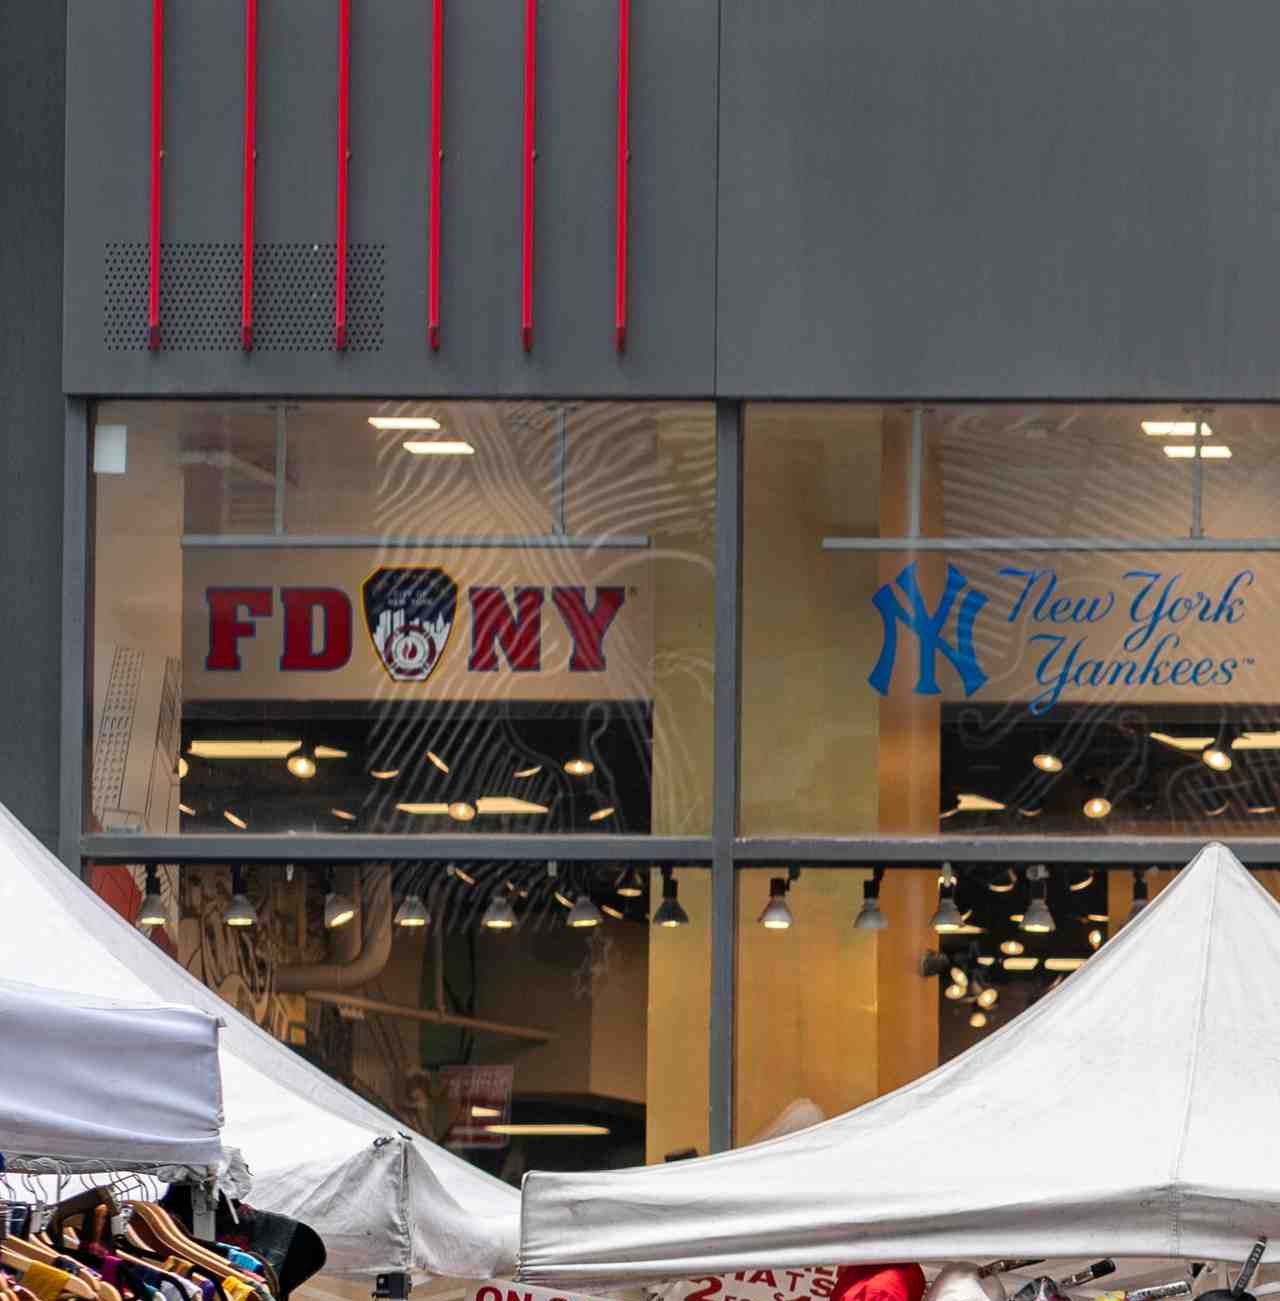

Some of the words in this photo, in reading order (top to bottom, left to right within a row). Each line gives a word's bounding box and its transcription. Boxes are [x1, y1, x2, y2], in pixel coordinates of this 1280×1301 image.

[867, 560, 990, 697] NY
[997, 567, 1116, 624] New
[1122, 569, 1255, 652] York
[1027, 633, 1240, 716] Yankees
[732, 1267, 836, 1298] ATS
